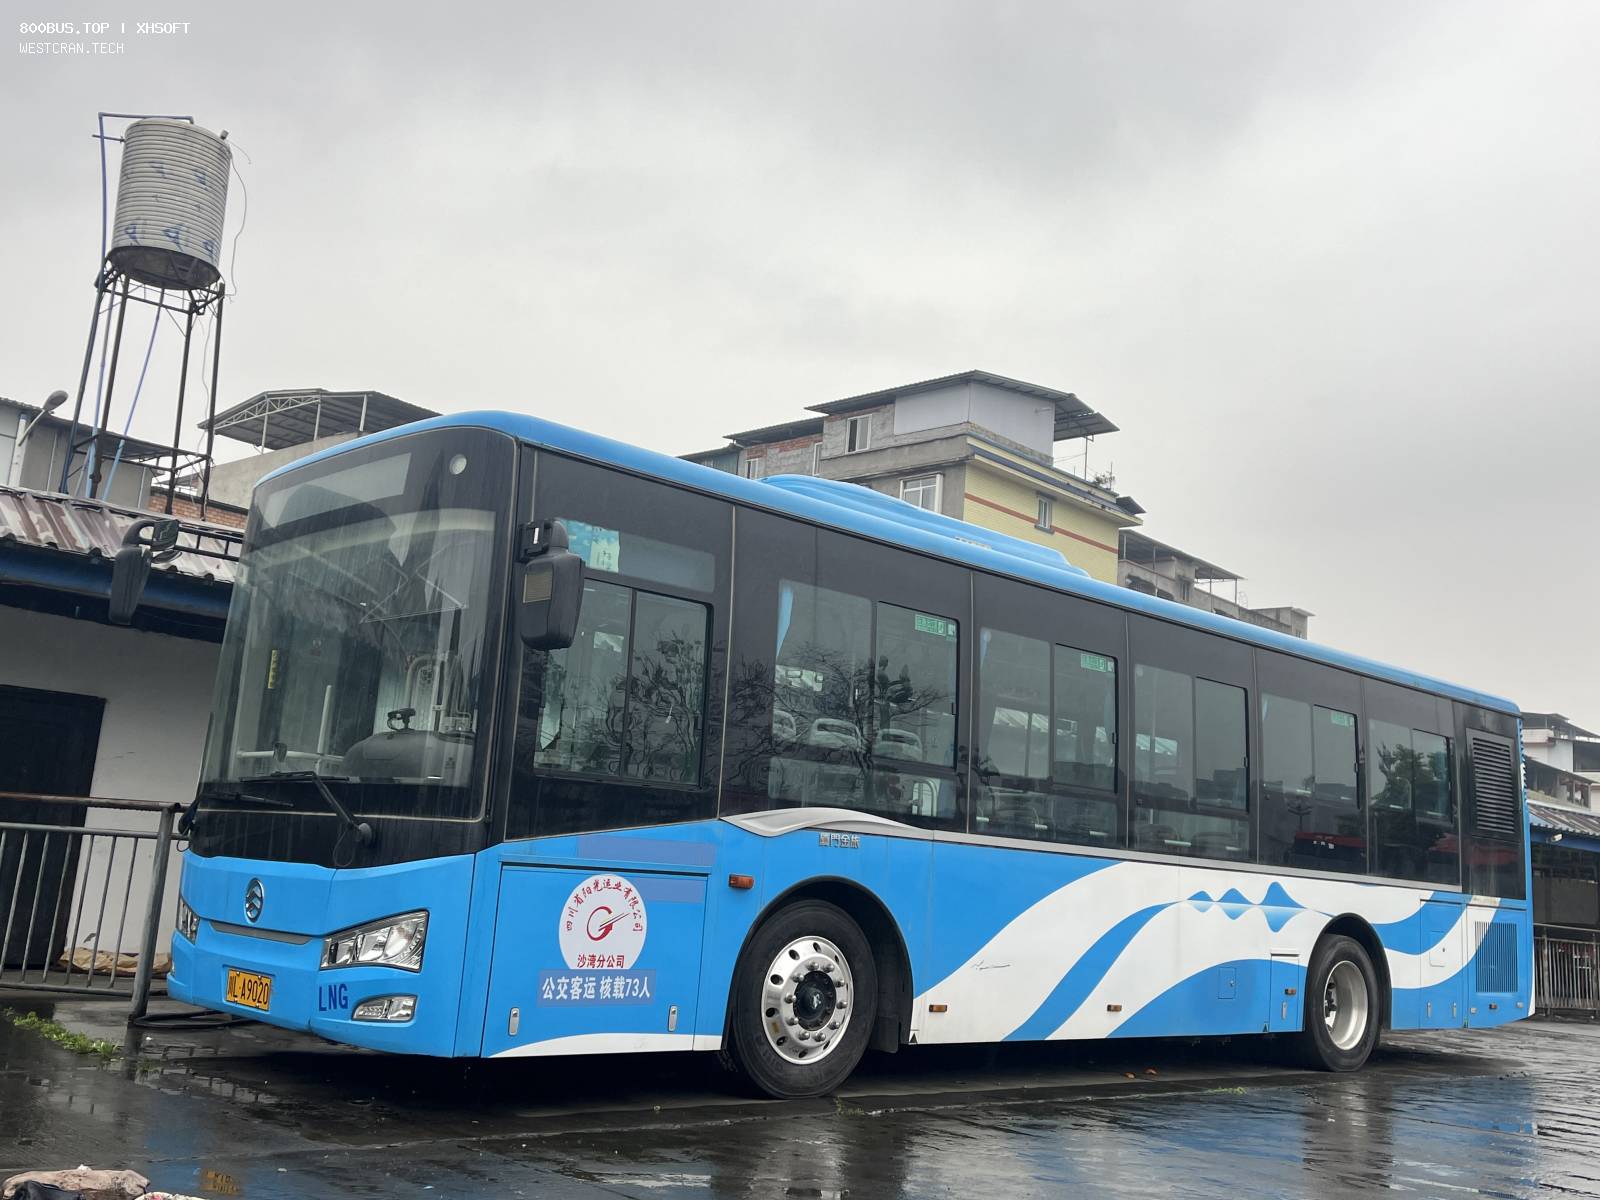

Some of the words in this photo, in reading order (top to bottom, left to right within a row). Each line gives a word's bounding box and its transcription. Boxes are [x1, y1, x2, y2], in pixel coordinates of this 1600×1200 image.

[577, 954, 625, 968] 沙湾分公司
[319, 983, 348, 1011] LNG
[542, 976, 596, 1000] 公交客运
[599, 976, 650, 999] 核载73人
